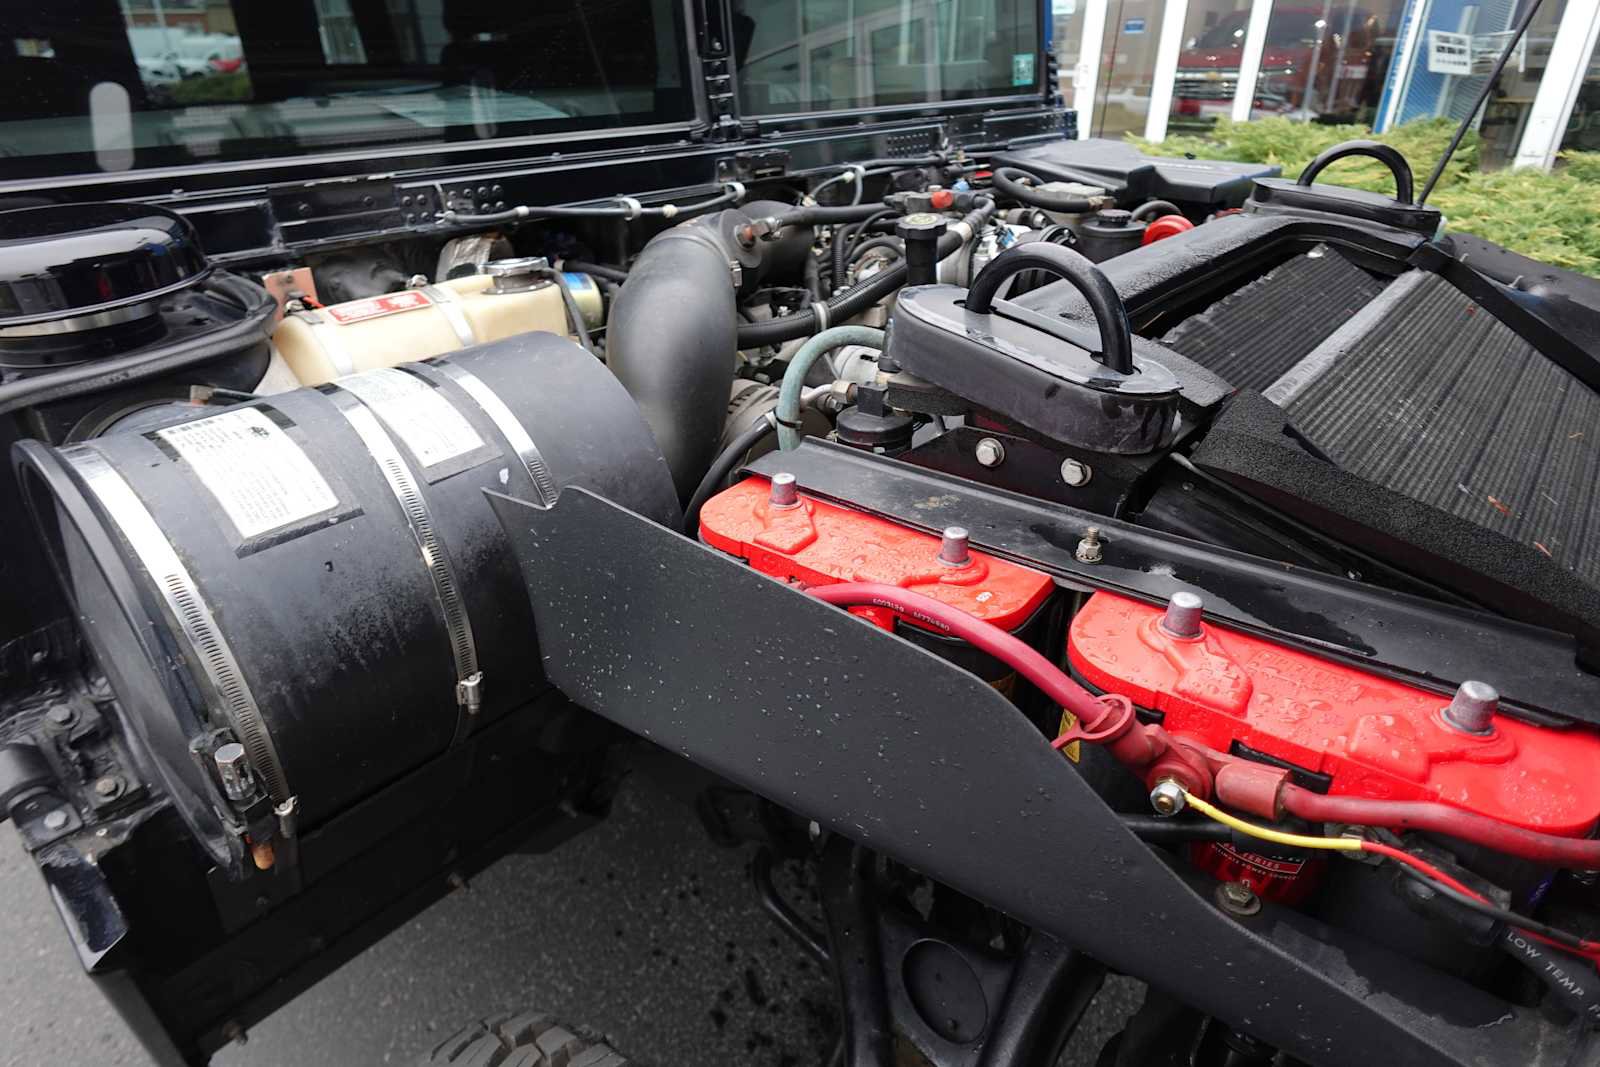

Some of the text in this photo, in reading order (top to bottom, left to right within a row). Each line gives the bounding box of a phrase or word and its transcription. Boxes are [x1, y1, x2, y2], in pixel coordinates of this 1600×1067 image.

[1242, 852, 1281, 870] SERIES
[1507, 932, 1585, 996] LOW TEMP
